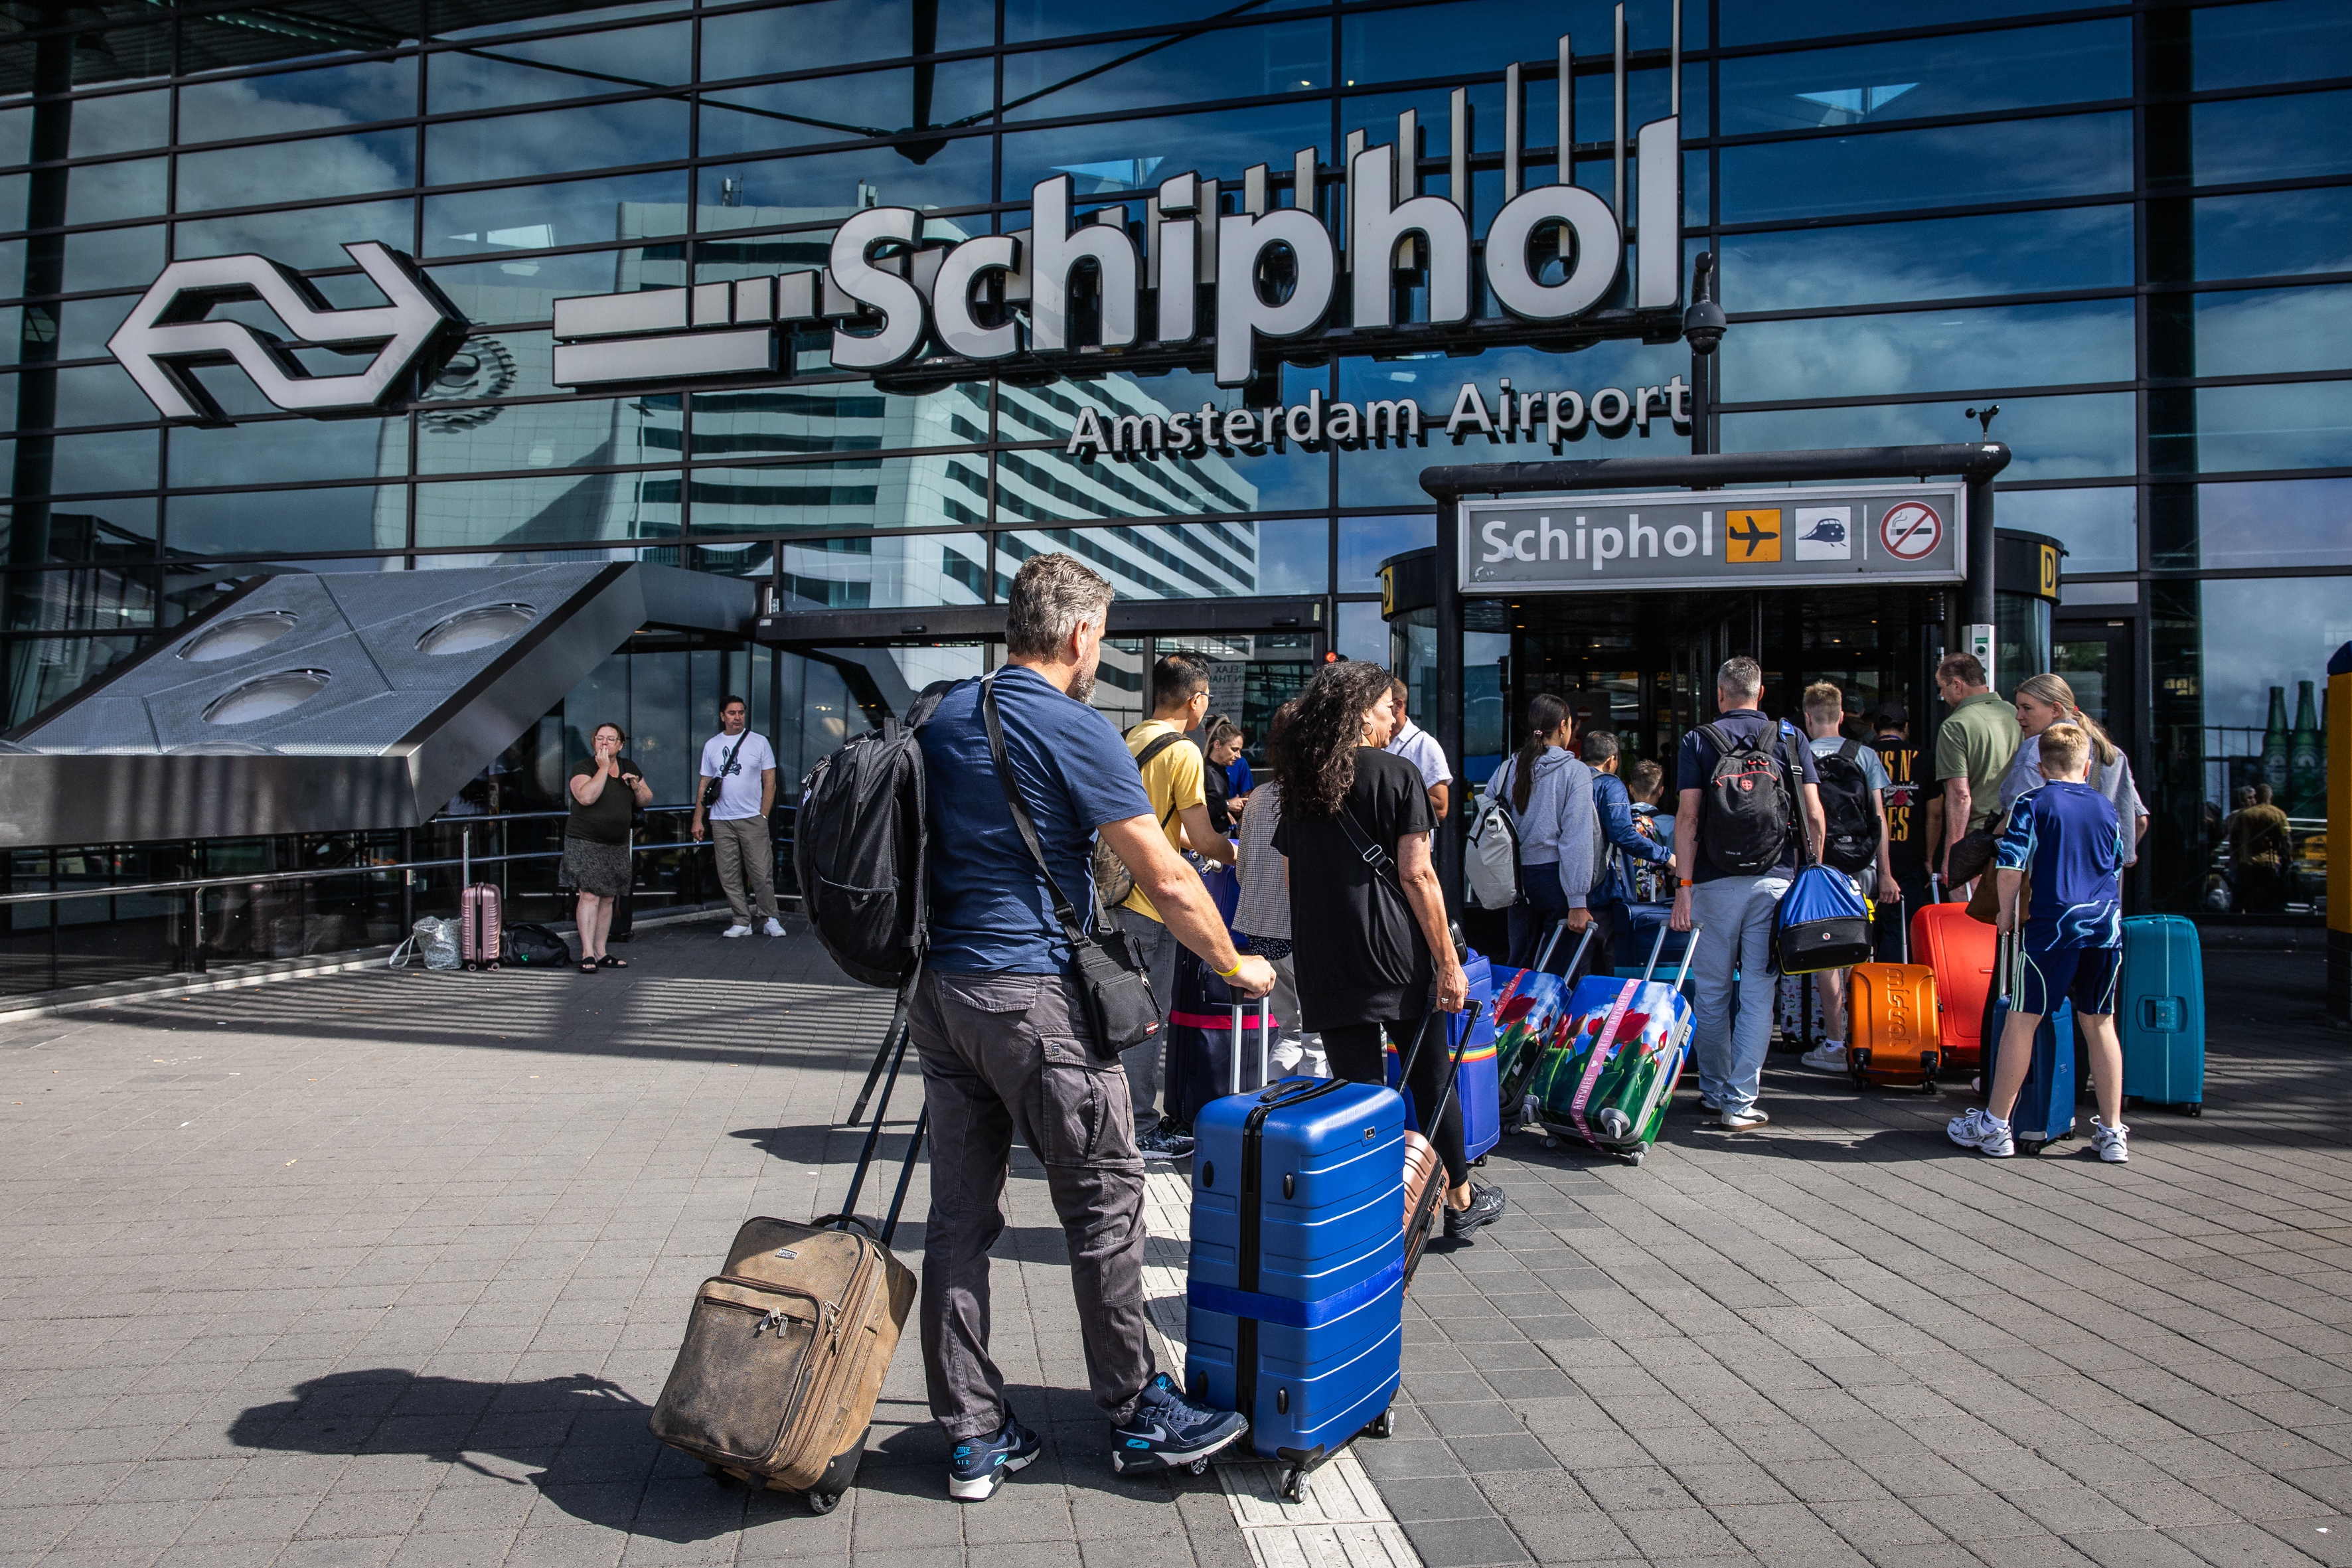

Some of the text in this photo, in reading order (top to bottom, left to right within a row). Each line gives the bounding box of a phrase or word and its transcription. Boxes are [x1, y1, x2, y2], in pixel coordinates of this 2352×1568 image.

[830, 116, 1680, 386] Schiphol
[1067, 376, 1690, 455] Amsterdam Airport
[1481, 510, 1713, 570] Schiphol
[1384, 574, 1391, 607] D
[2045, 551, 2053, 588] D
[1604, 1027, 1614, 1036] ME
[1609, 992, 1632, 1025] ANYWHERE
[1573, 1073, 1595, 1110] ANYWHERE
